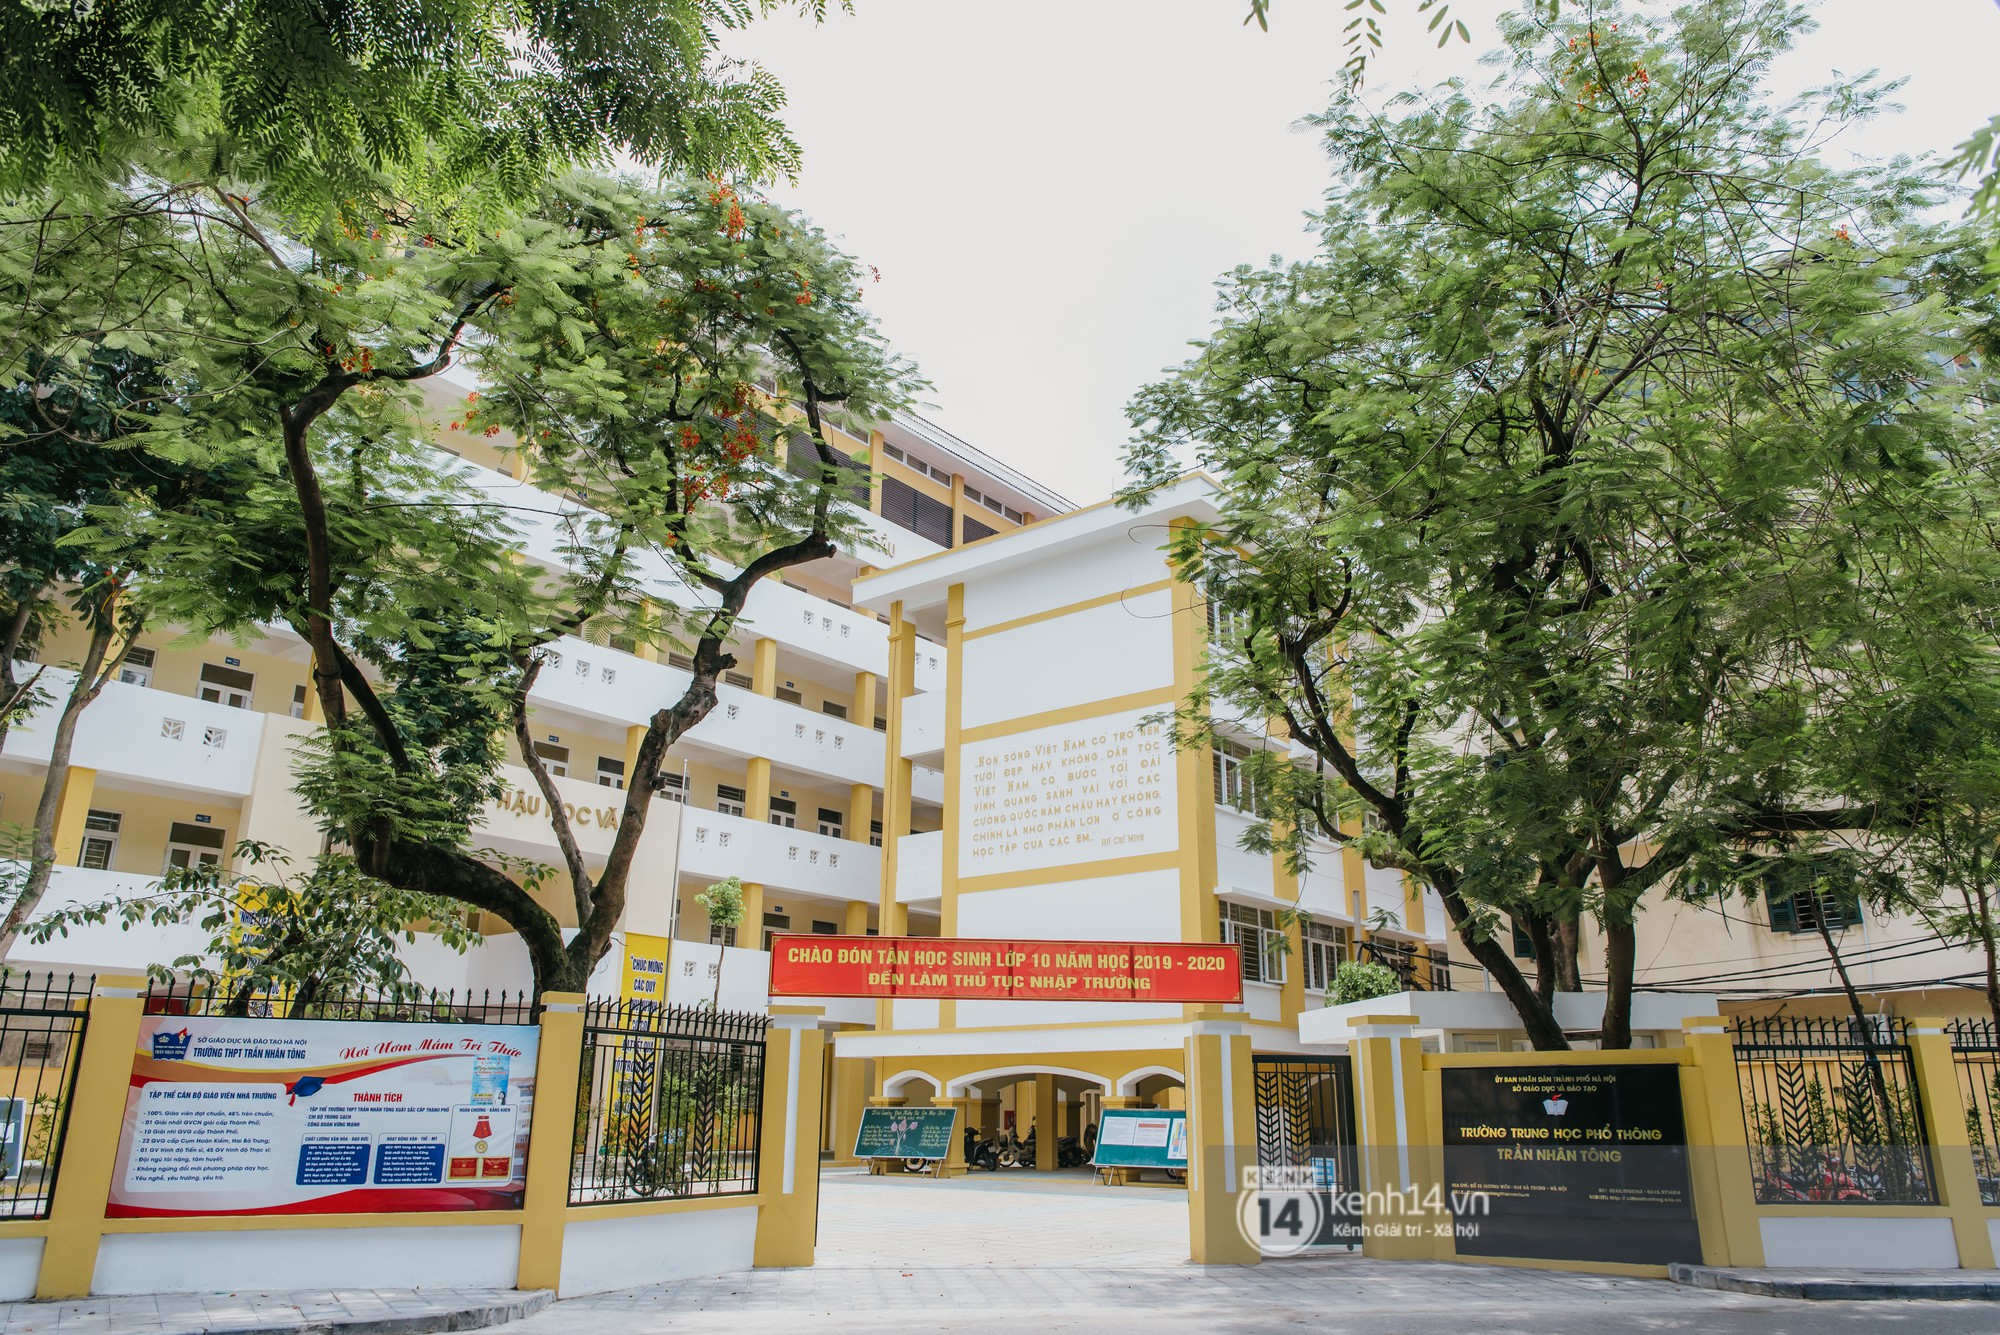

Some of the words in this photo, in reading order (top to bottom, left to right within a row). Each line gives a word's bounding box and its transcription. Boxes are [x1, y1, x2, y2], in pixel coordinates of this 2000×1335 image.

[1063, 738, 1085, 751] NAM
[1032, 761, 1052, 773] HAY
[1007, 780, 1029, 792] NAM
[1004, 794, 1038, 808] QUANG
[1082, 781, 1099, 794] VAI
[1096, 795, 1117, 808] HAY
[595, 806, 622, 831] VĂ
[1127, 806, 1161, 819] CÔNG
[788, 945, 833, 964] CHÀO
[837, 946, 873, 965] ĐÓN
[877, 947, 909, 965] TÂN
[914, 950, 947, 969] HỌC
[952, 950, 991, 967] SINH
[996, 949, 1026, 968] LỚP
[1031, 953, 1050, 968] 10
[1056, 950, 1092, 969] NĂM
[1097, 954, 1129, 972] HỌC
[1134, 955, 1172, 970] 2019
[1187, 956, 1225, 971] 2020
[633, 976, 645, 992] CÁC
[868, 969, 904, 986] ĐẾN
[910, 971, 948, 987] LÀM
[953, 971, 986, 987] THỦ
[992, 975, 1024, 990] TỤC
[1030, 973, 1078, 992] NHẬP
[1083, 974, 1151, 990] TRƯỜNG
[197, 1036, 208, 1044] SỞ
[208, 1036, 225, 1044] GIÁO
[227, 1037, 242, 1046] DỤC
[243, 1037, 252, 1045] VÀ
[253, 1037, 268, 1045] ĐÀO
[269, 1038, 283, 1046] TẠO
[284, 1037, 293, 1045] HÀ
[295, 1038, 307, 1046] NỘI
[193, 1046, 223, 1058] TRƯỜNG
[224, 1048, 243, 1058] THPT
[264, 1047, 286, 1059] NHÂN
[287, 1048, 306, 1060] TÔNG
[1518, 1075, 1537, 1083] NHÂN
[1538, 1075, 1552, 1083] DÂN
[1553, 1075, 1575, 1083] THÀNH
[1576, 1074, 1591, 1083] PHỐ
[1592, 1075, 1602, 1083] HÀ
[1603, 1074, 1616, 1084] NỘI
[149, 1090, 162, 1101] TẬP
[163, 1089, 177, 1099] THỂ
[177, 1091, 191, 1099] CÁN
[192, 1090, 202, 1100] BỘ
[203, 1091, 219, 1100] GIÁO
[220, 1091, 235, 1100] VIÊN
[236, 1091, 250, 1100] NHÀ
[251, 1091, 277, 1100] TRƯỜNG
[1512, 1084, 1522, 1092] SỞ
[1523, 1084, 1540, 1092] GIÁO
[1541, 1085, 1555, 1093] DỤC
[1556, 1084, 1566, 1092] VÀ
[1567, 1084, 1582, 1092] ĐÀO
[1583, 1085, 1597, 1093] TẠO
[353, 1091, 382, 1103] THÀNH
[383, 1092, 403, 1103] TÍCH
[1460, 1124, 1507, 1139] TRƯỜNG
[1511, 1127, 1550, 1139] TRUNG
[1553, 1128, 1582, 1142] HỌC
[1586, 1123, 1613, 1140] PHỔ
[1617, 1127, 1662, 1141] THÔNG
[1497, 1143, 1533, 1161] TRẦN
[1537, 1146, 1577, 1162] NHÂN
[1580, 1147, 1622, 1163] TÔNG
